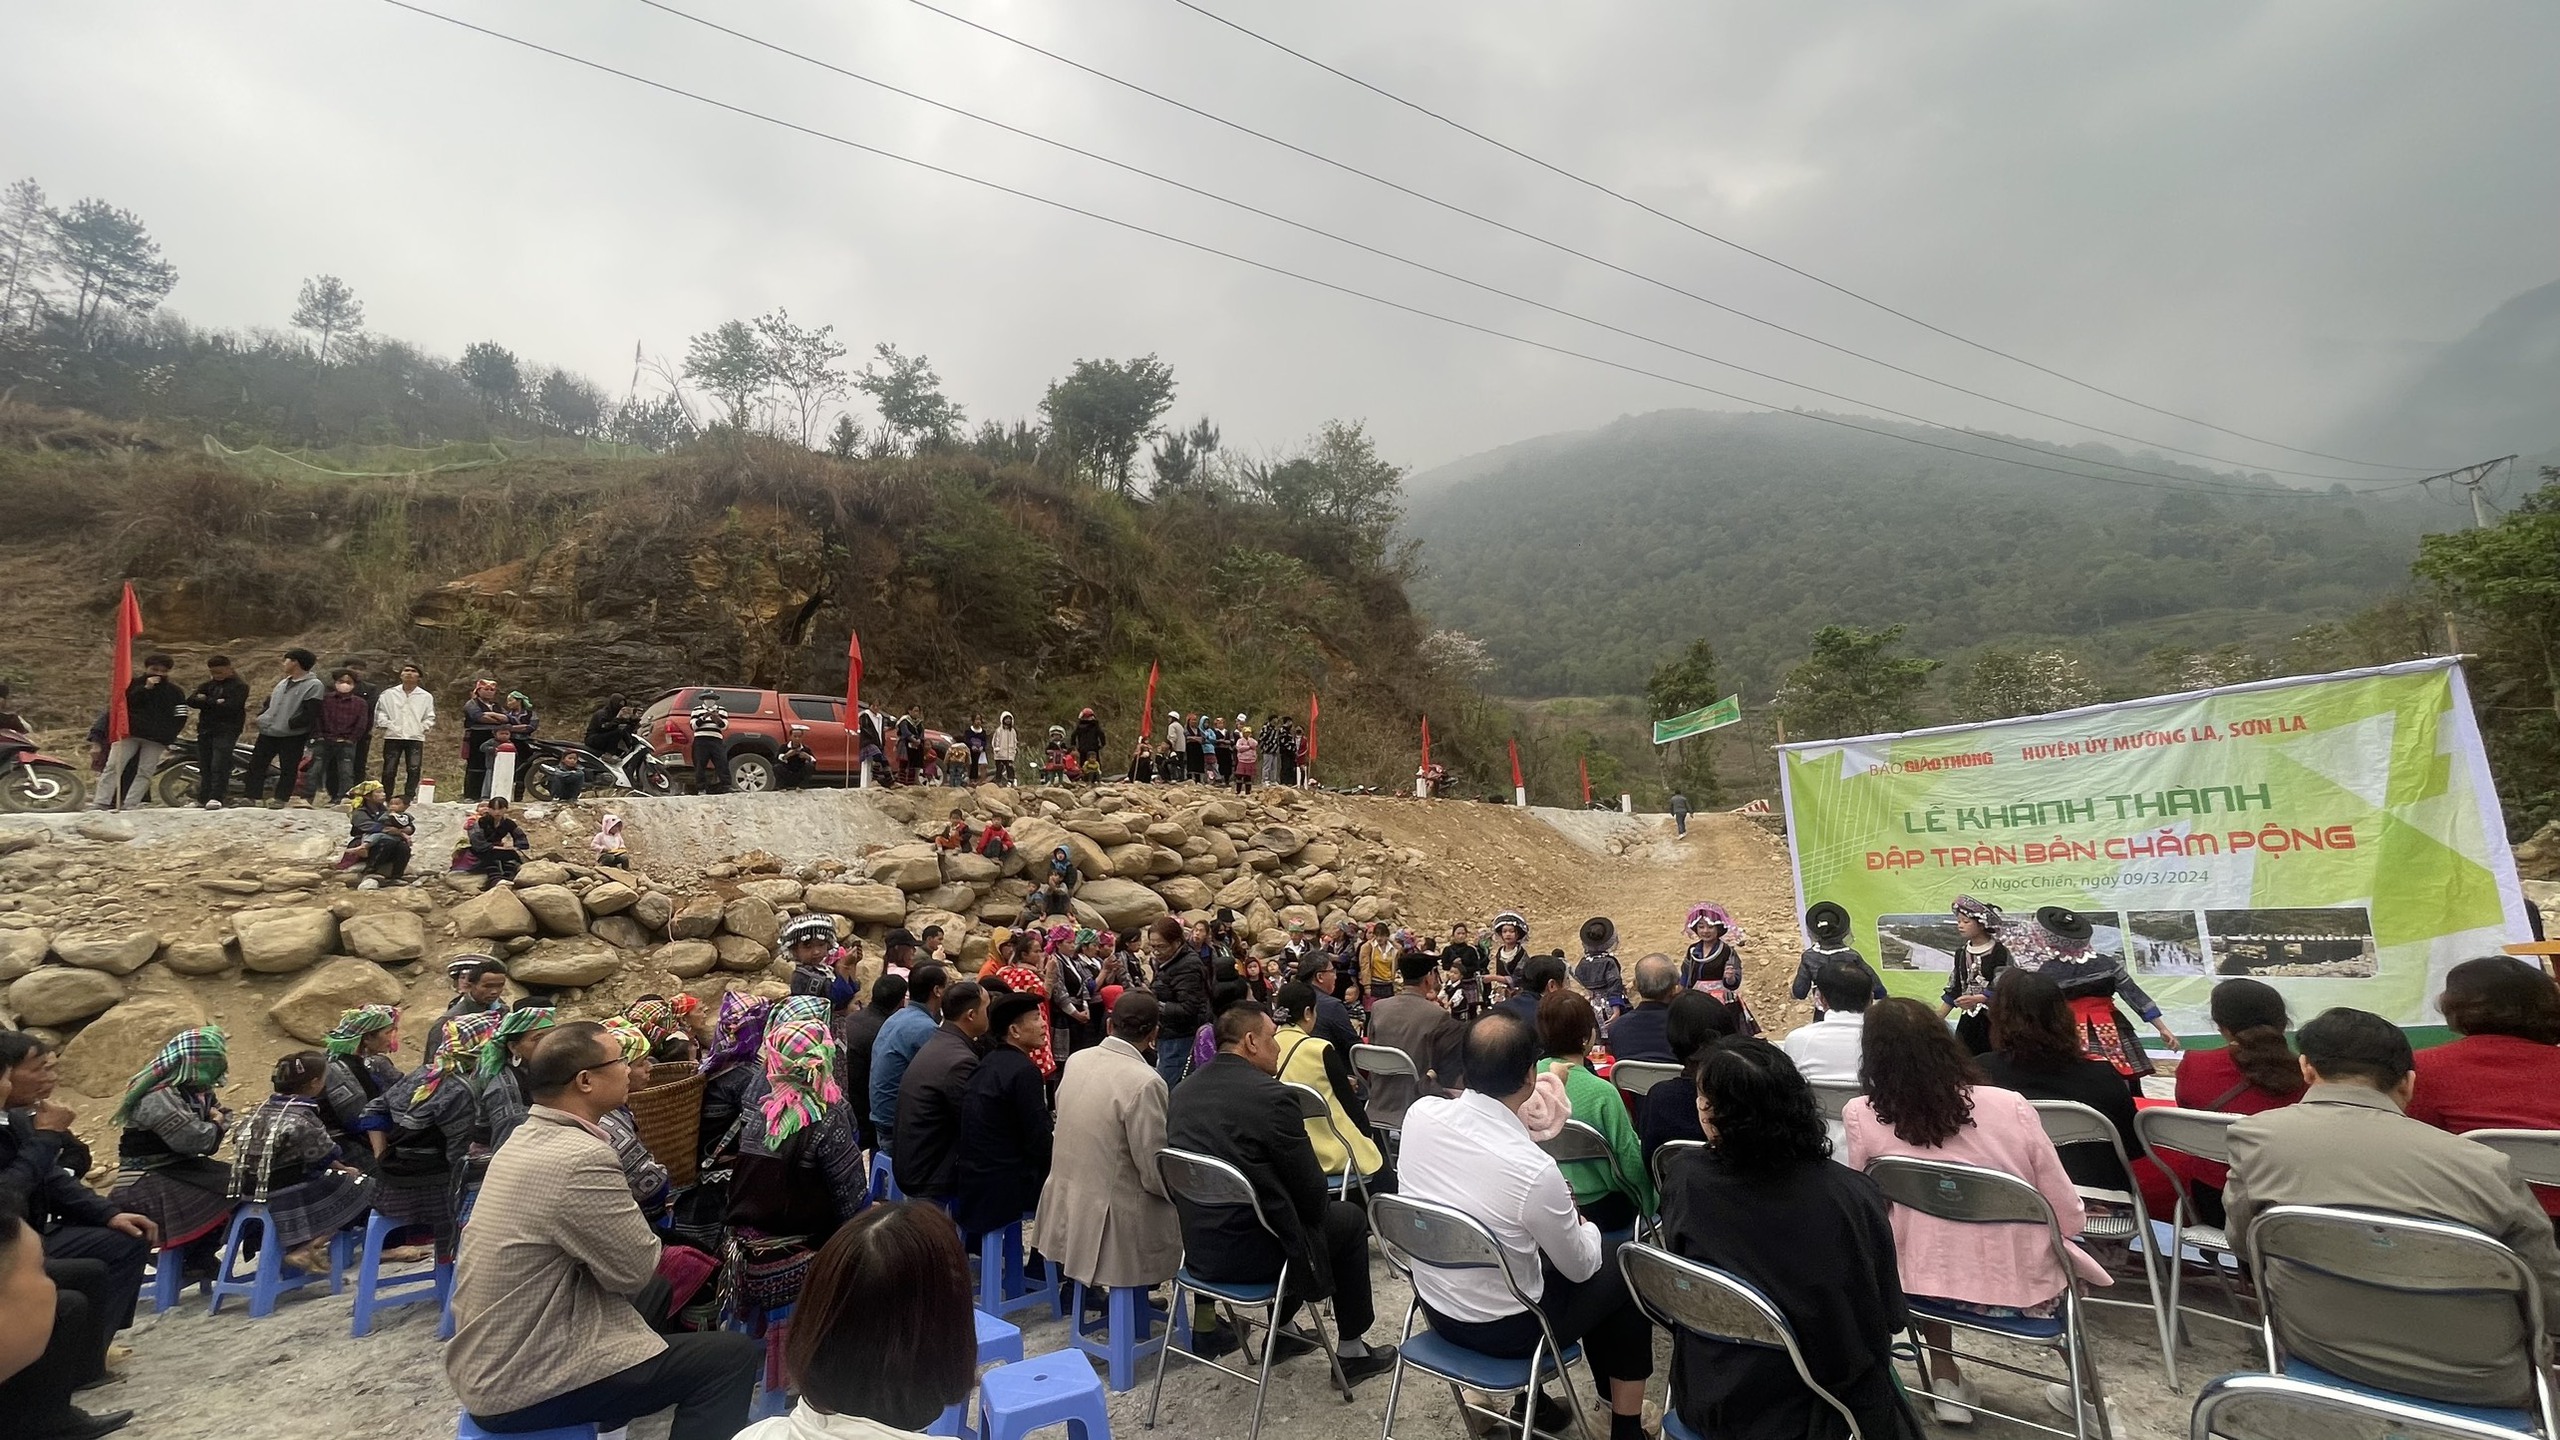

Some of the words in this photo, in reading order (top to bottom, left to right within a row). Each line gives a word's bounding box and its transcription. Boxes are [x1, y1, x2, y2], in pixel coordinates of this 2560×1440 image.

[2022, 740, 2080, 761] HUYỆN
[2085, 735, 2107, 754] ỦY
[2113, 729, 2186, 752] MƯỜNG
[2191, 725, 2224, 742] LA,
[2228, 719, 2272, 738] SƠN
[2278, 715, 2307, 732] LA
[1904, 802, 1947, 834] LỄ
[1956, 798, 2095, 831] KHÁNH
[2106, 783, 2272, 820] THÀNH
[1866, 845, 1925, 875] ĐẬP
[1930, 841, 2017, 867] TRÀN
[2024, 834, 2096, 864] BẢN
[2104, 828, 2219, 860] CHĂM
[2228, 823, 2356, 860] PỘNG
[1992, 877, 2028, 892] Ngọc
[2031, 874, 2077, 888] Chiến,
[2081, 873, 2119, 889] ngày
[2123, 870, 2209, 886] 09/3/2024
